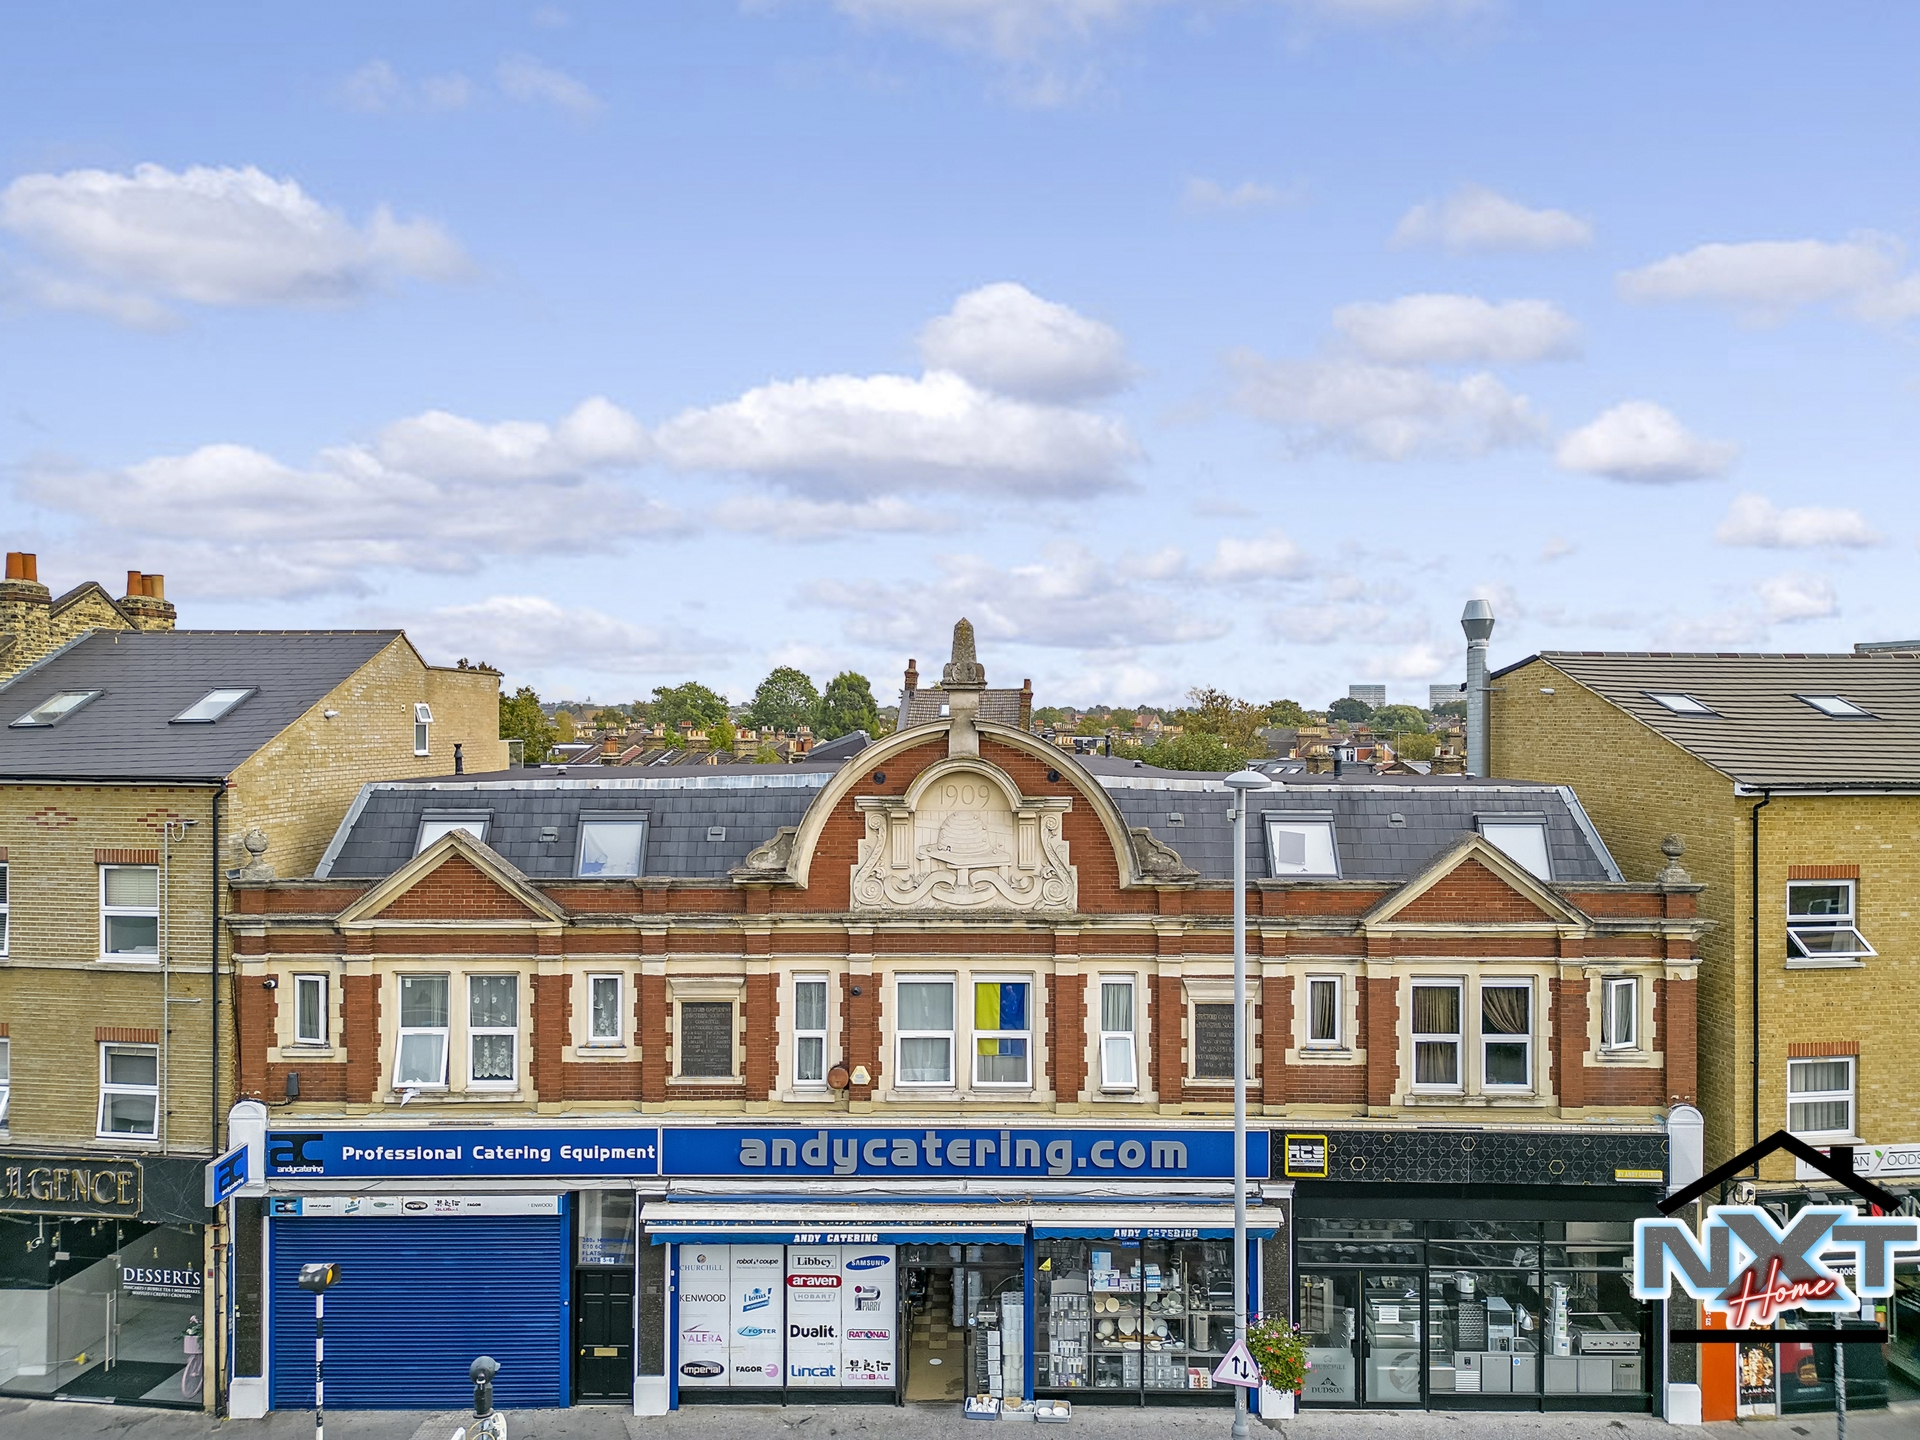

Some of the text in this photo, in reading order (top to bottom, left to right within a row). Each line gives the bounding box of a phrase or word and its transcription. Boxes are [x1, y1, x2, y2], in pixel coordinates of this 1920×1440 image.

[939, 784, 991, 808] 1909
[342, 1145, 656, 1162] Professional Catering Equipment
[739, 1131, 1188, 1175] andycatering.com
[277, 1165, 324, 1174] andycatering
[793, 1233, 878, 1243] ANDY CATERING
[1113, 1229, 1198, 1237] ANDY CATERING
[123, 1267, 200, 1285] DESSERTS
[793, 1276, 837, 1286] araven
[680, 1294, 726, 1302] KENWOOD
[862, 1301, 881, 1311] PARRY
[682, 1334, 722, 1342] VALERA
[683, 1365, 721, 1375] imperial
[791, 1365, 836, 1377] Lincat
